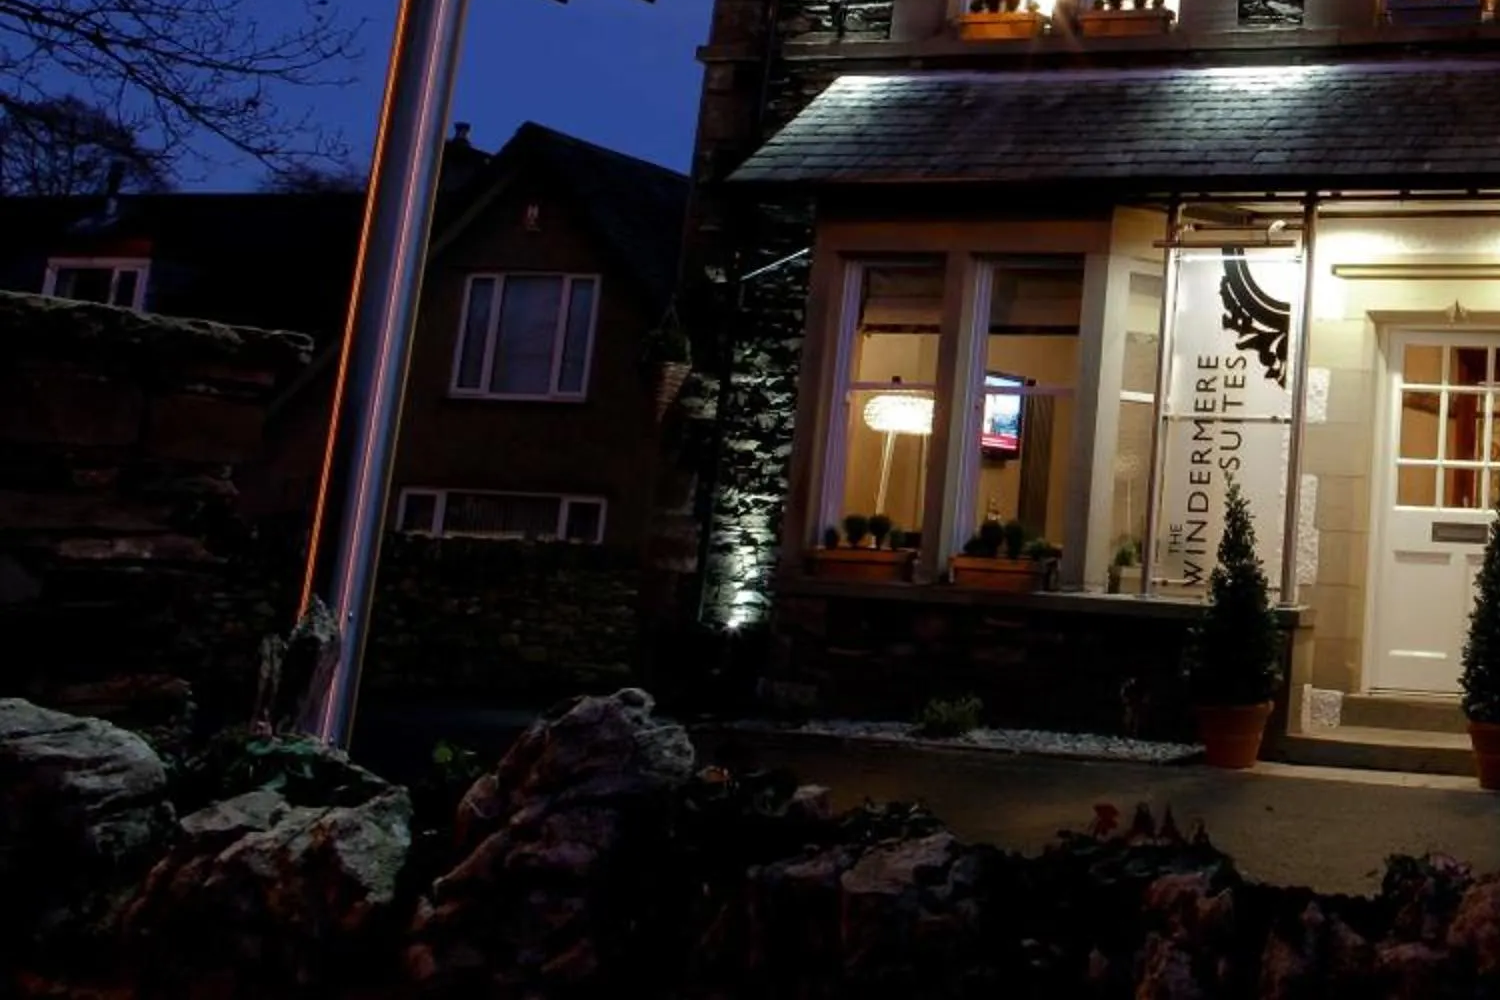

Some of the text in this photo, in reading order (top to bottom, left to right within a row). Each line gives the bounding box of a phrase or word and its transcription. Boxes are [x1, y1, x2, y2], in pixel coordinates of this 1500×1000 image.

[1183, 354, 1219, 587] WINDERMERE
[1218, 354, 1247, 471] SUITES
[1168, 522, 1184, 555] THE
